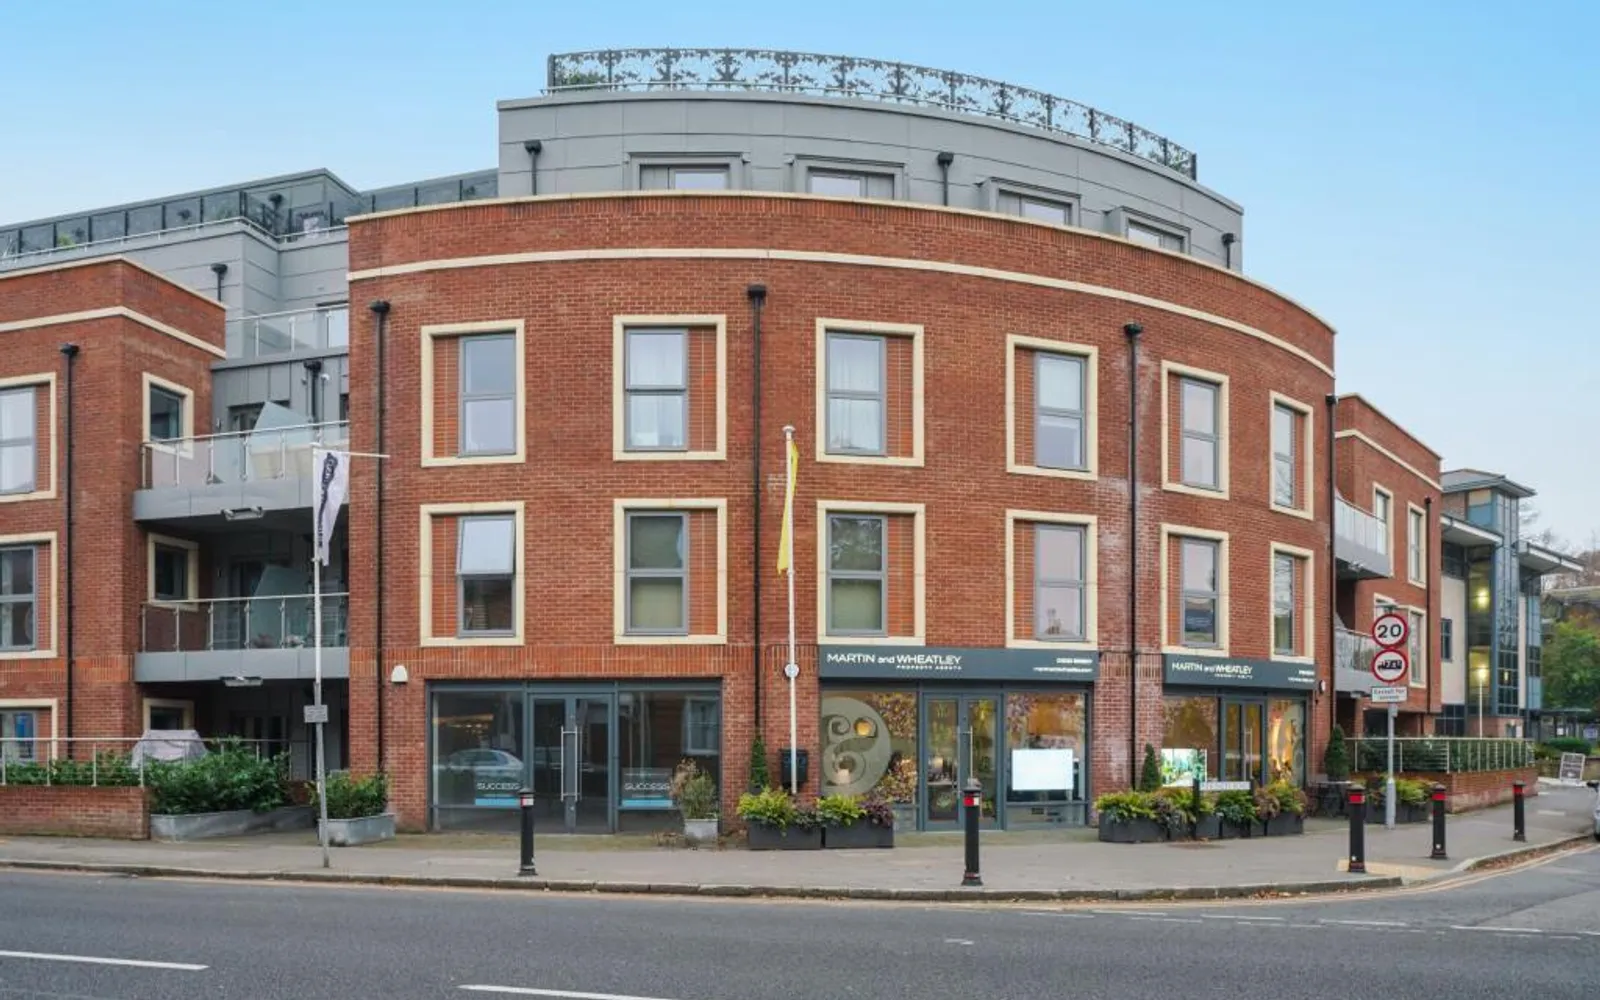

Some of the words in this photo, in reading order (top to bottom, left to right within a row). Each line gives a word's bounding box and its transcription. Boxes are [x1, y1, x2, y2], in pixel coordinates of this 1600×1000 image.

[1377, 624, 1402, 638] 20
[827, 653, 876, 664] MARTIN
[877, 656, 895, 664] and
[896, 654, 962, 665] WHEATLEY
[1171, 662, 1203, 672] MARTIN
[1215, 664, 1253, 675] WHEATLEY
